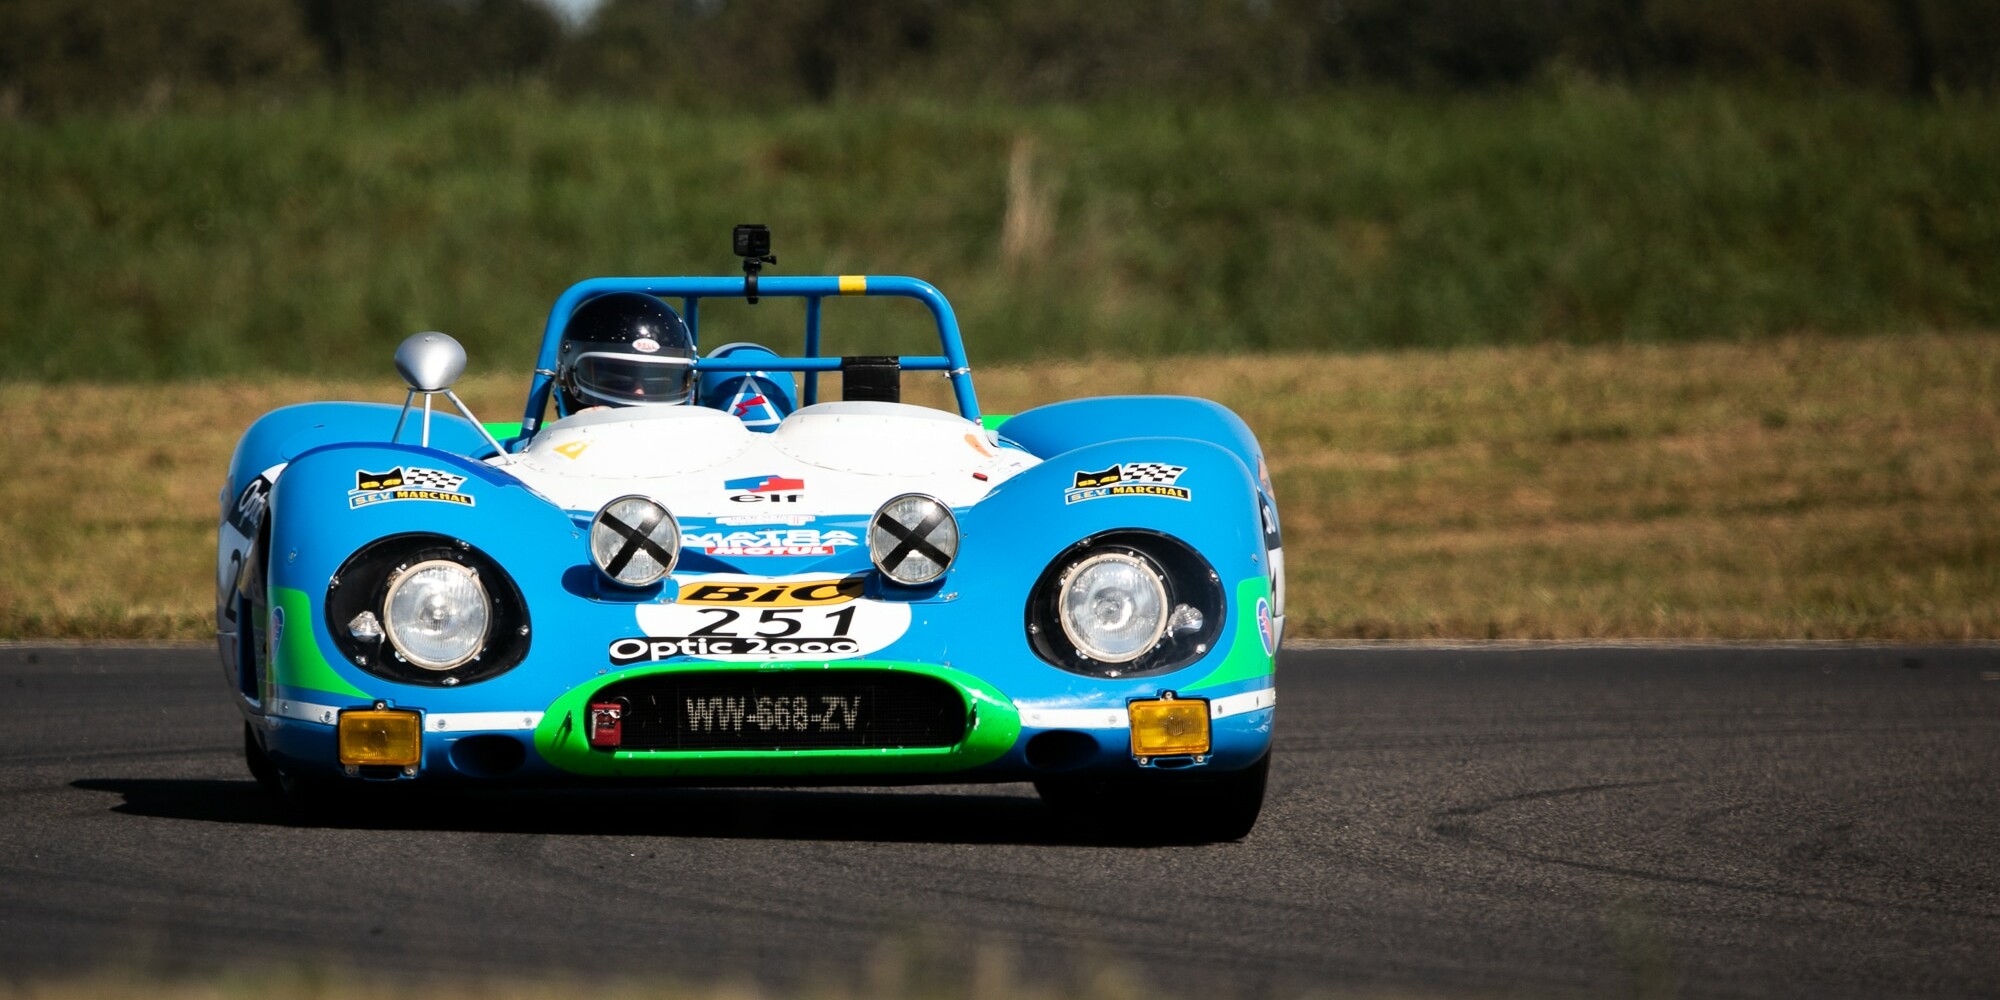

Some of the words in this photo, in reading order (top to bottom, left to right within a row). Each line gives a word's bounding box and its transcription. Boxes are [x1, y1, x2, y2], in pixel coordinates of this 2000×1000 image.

[396, 491, 468, 503] MARCHAL
[1113, 486, 1184, 498] MARCHAL
[729, 494, 804, 503] elf
[712, 547, 830, 555] MOTUL
[688, 606, 856, 638] 251
[609, 638, 733, 662] Optic
[746, 638, 860, 655] 2000
[686, 696, 861, 732] WW-668-ZV
